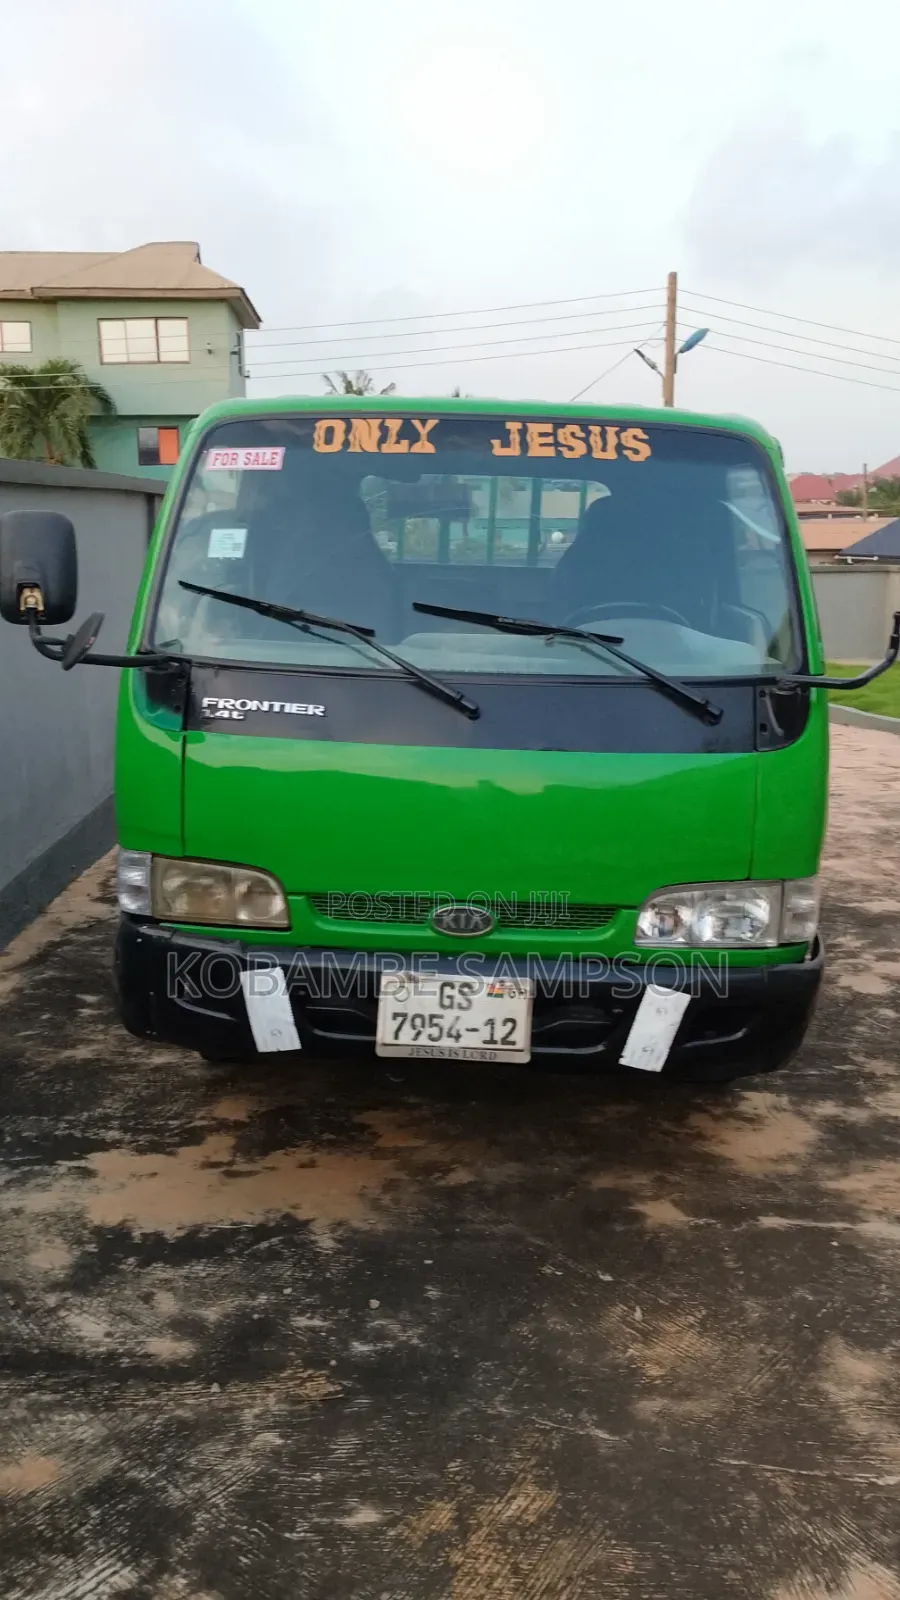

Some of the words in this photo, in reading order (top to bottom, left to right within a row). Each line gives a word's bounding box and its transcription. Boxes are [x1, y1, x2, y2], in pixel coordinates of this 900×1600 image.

[313, 418, 440, 454] ONLY
[491, 421, 652, 462] JESUS
[212, 452, 238, 466] FOR
[243, 452, 278, 466] SALE
[201, 697, 326, 716] FRONTIER
[440, 912, 486, 930] KIA
[438, 981, 474, 1011] GS
[391, 1011, 517, 1046] 7954-12
[408, 1047, 444, 1057] JESUS
